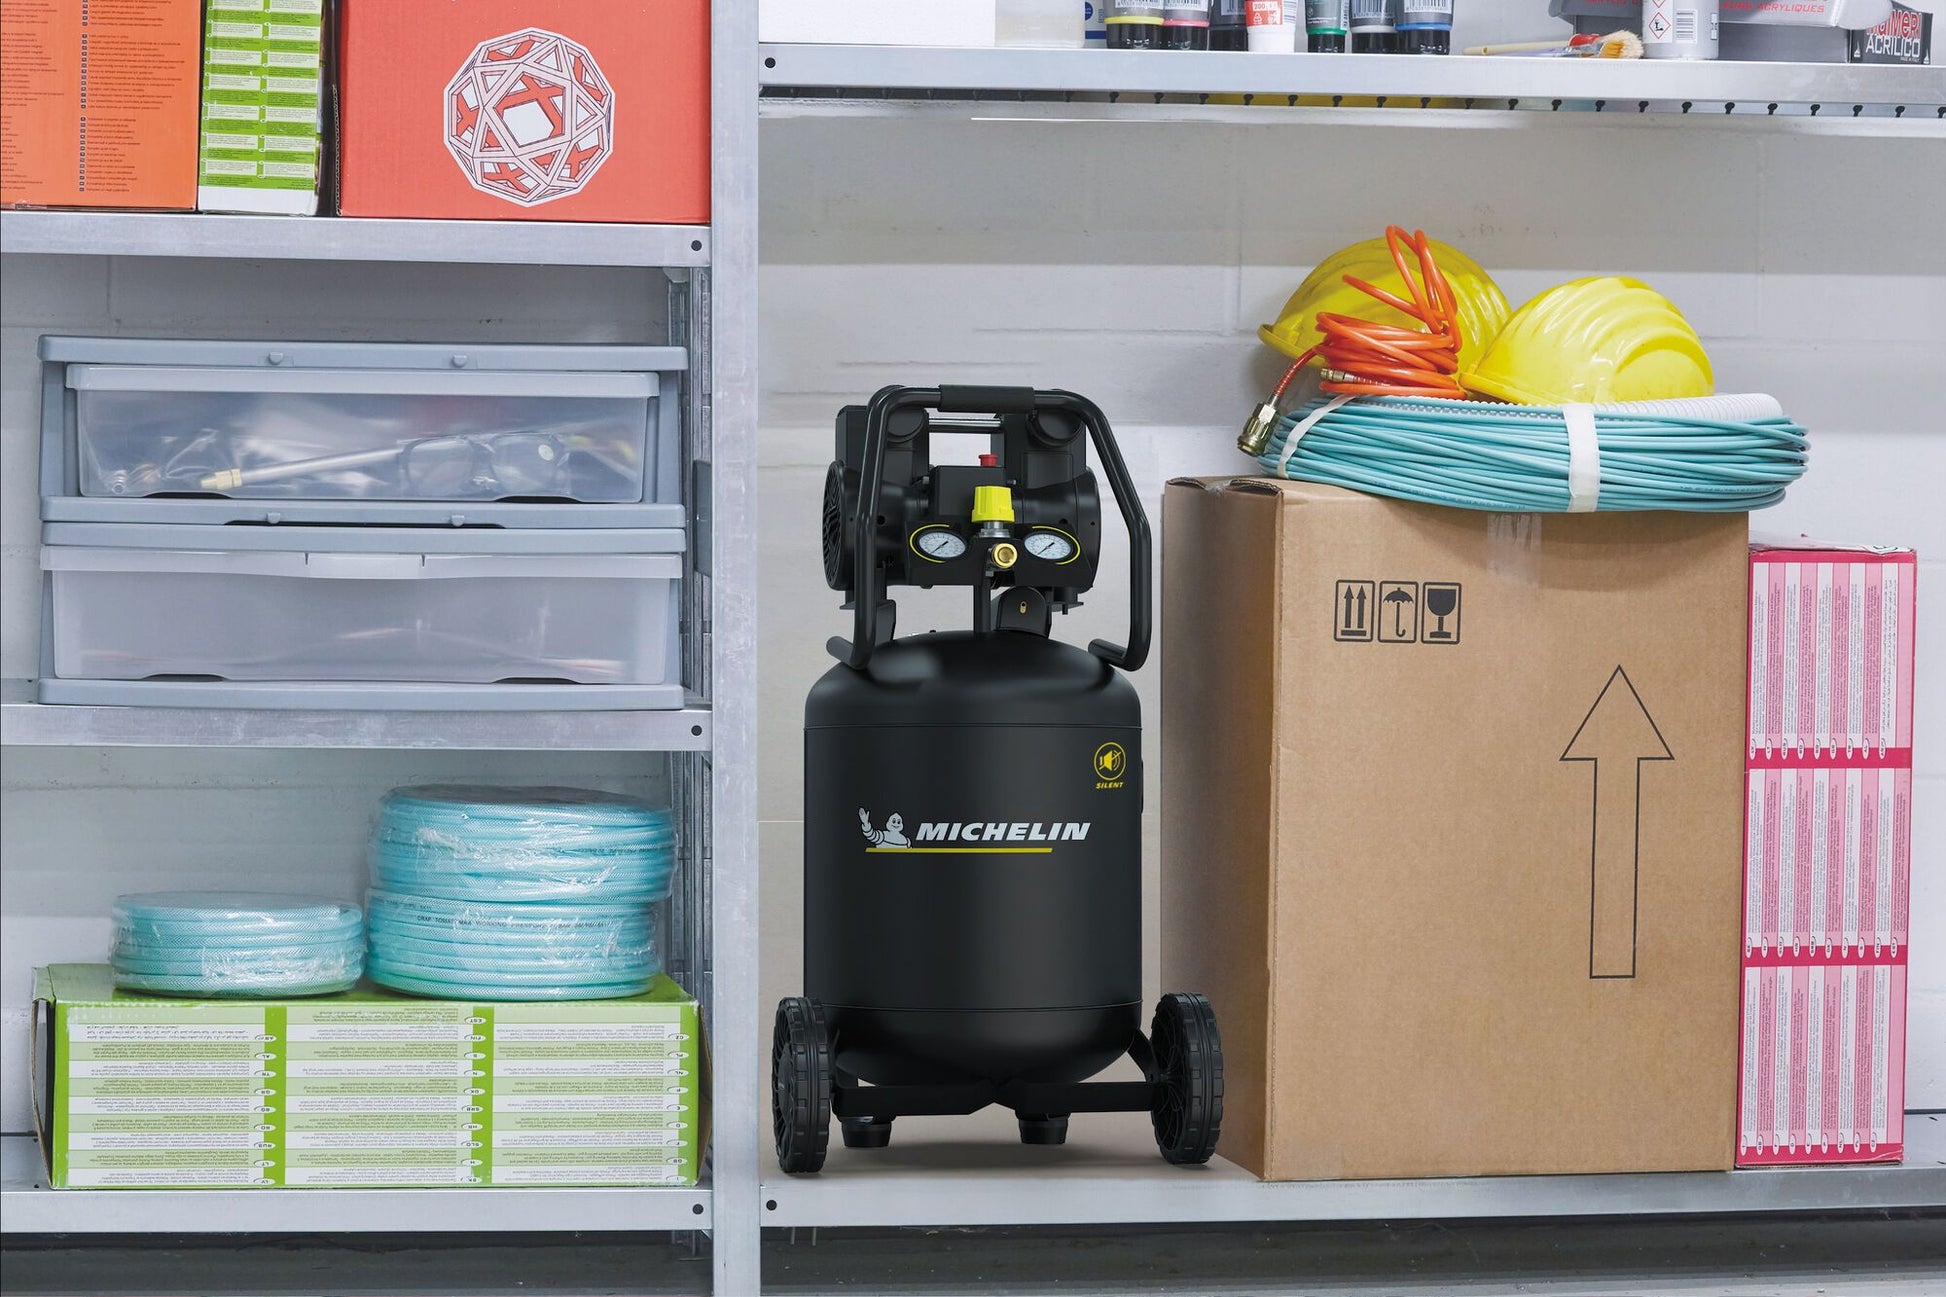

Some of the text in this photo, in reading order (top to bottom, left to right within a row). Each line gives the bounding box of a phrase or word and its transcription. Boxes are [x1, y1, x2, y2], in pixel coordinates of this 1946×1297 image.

[1758, 3, 1825, 13] ACRYLIQUES
[1865, 34, 1921, 58] ACRILICO
[1095, 782, 1124, 790] SILENT
[915, 822, 1092, 841] MICHELIN
